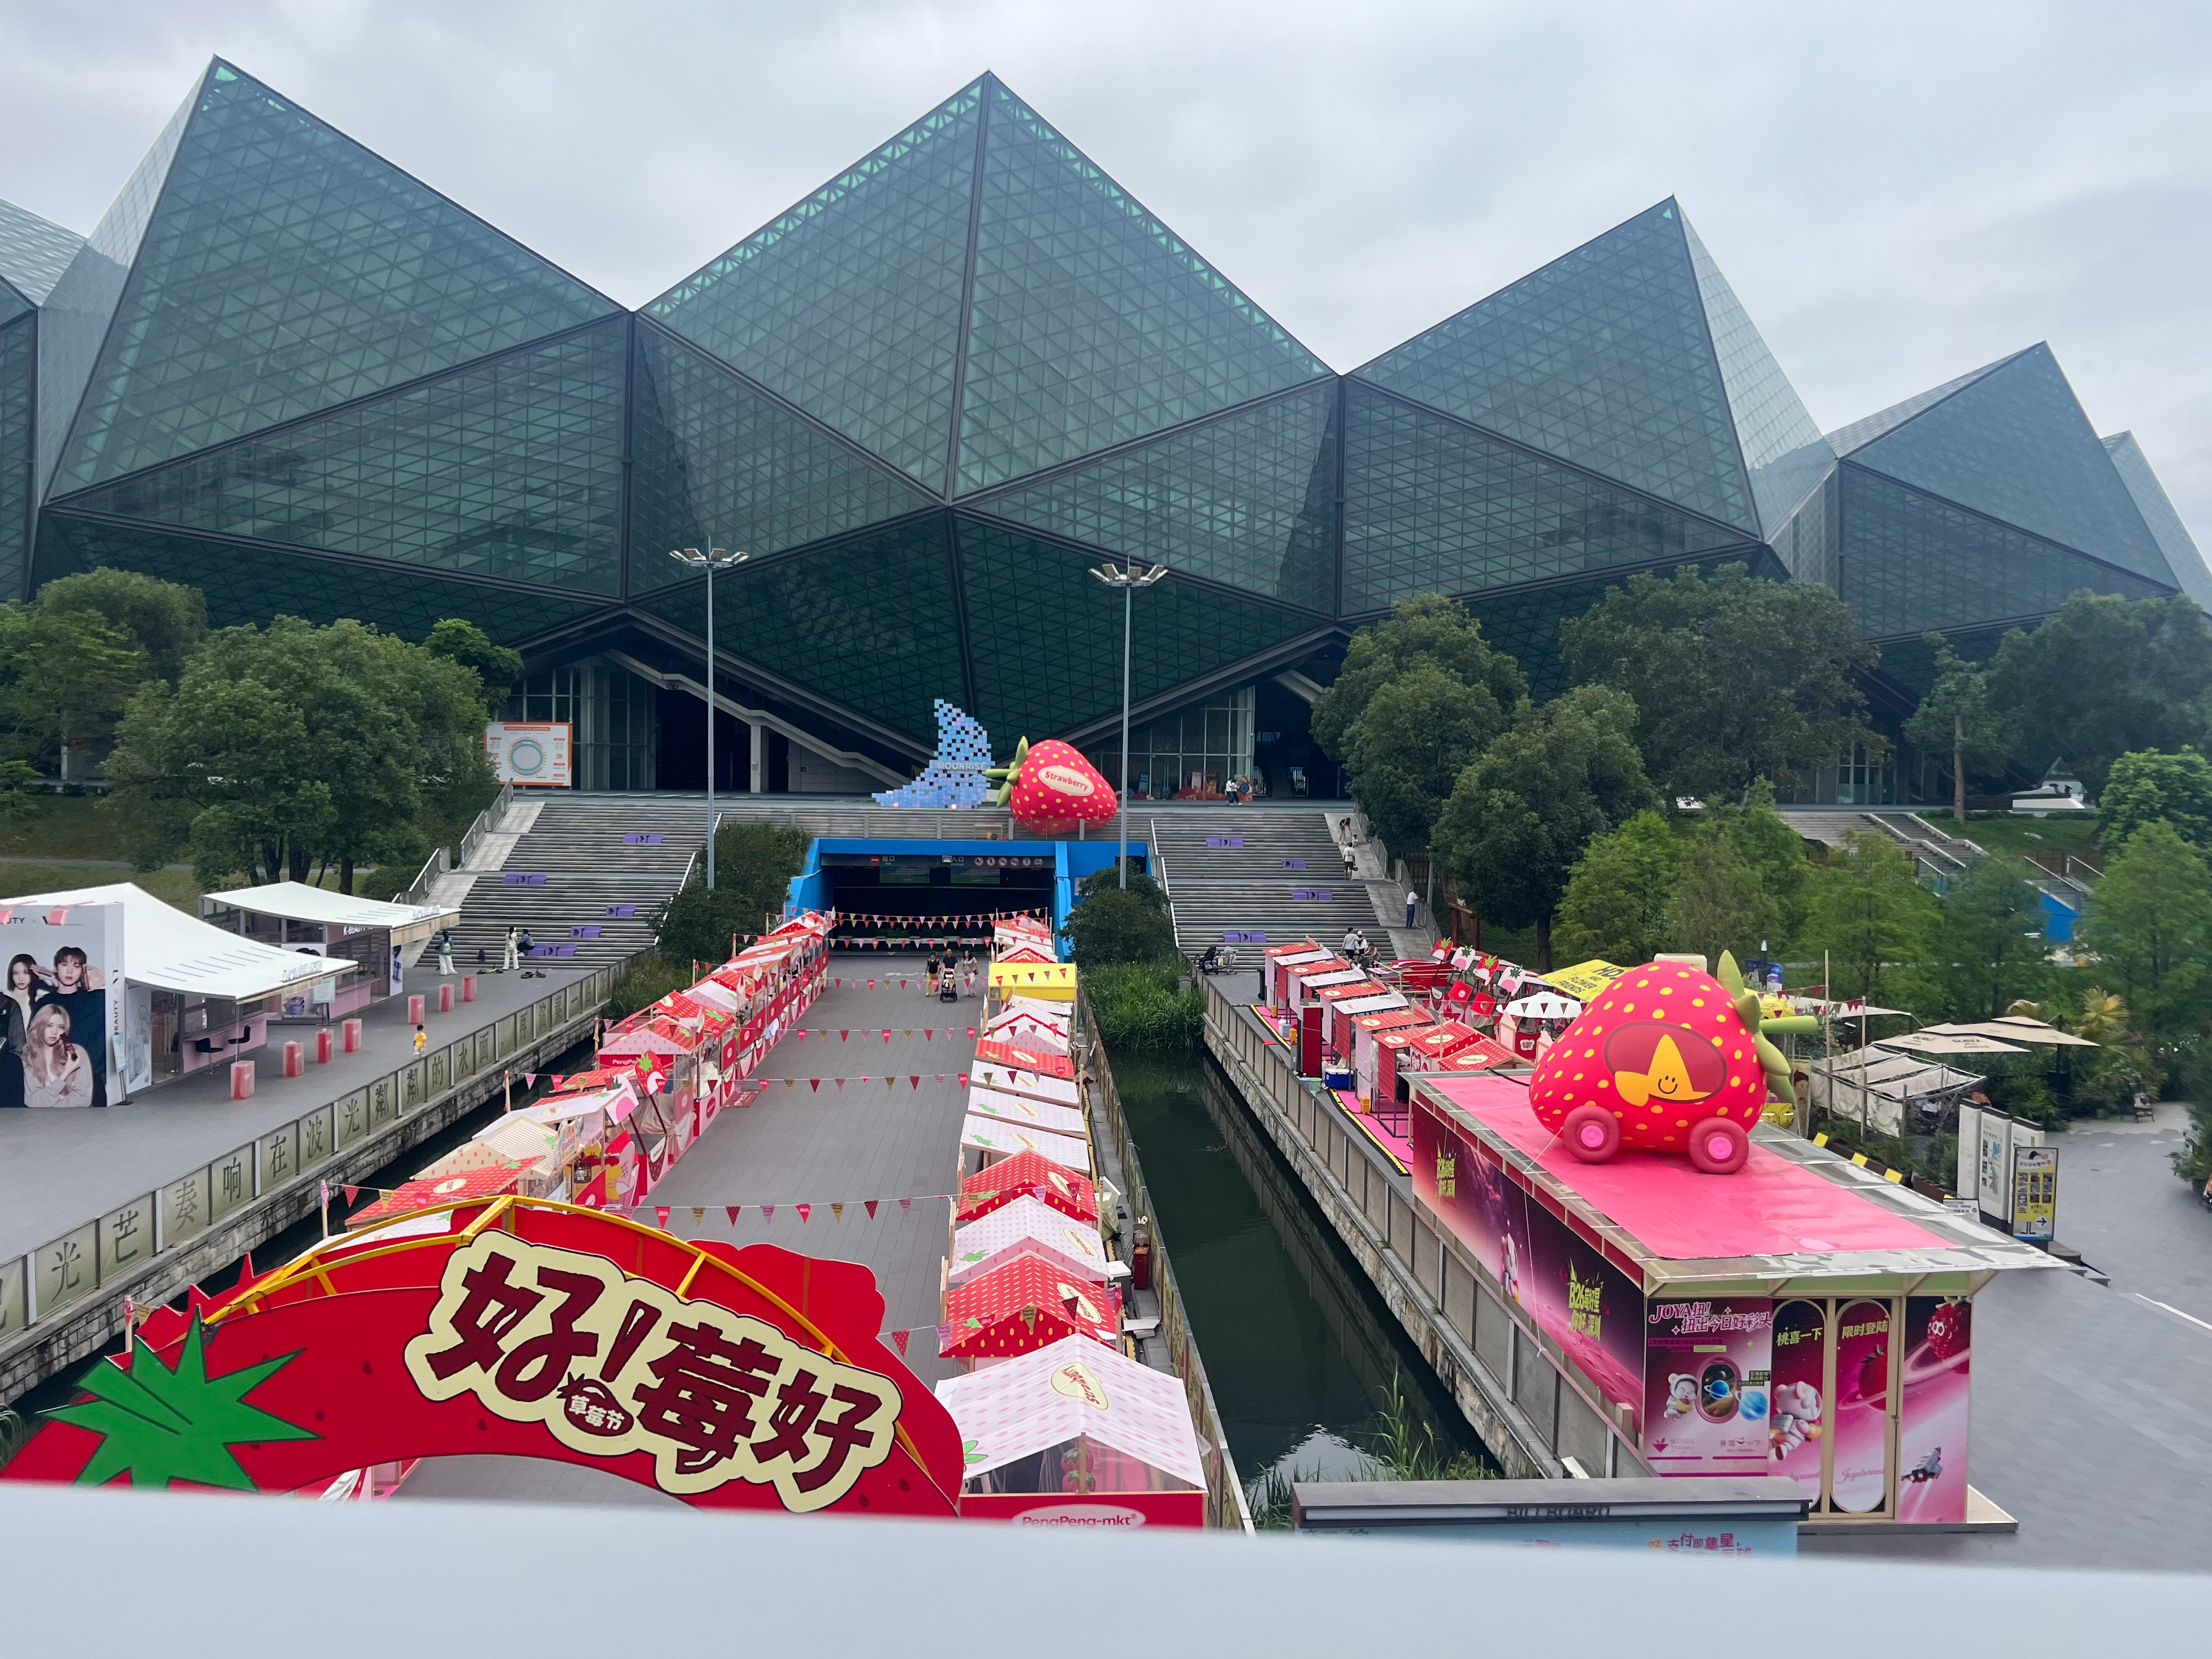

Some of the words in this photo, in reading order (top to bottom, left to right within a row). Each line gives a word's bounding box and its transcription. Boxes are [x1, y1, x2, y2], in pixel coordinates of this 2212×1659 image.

[1045, 771, 1089, 792] Strawberry
[1681, 1312, 1773, 1334] 扭出今日好彩头
[1841, 1321, 1889, 1339] 限时登陆
[1776, 1327, 1823, 1346] 桃喜一下
[1060, 1365, 1101, 1406] Strawberry
[568, 1395, 625, 1430] 草莓节
